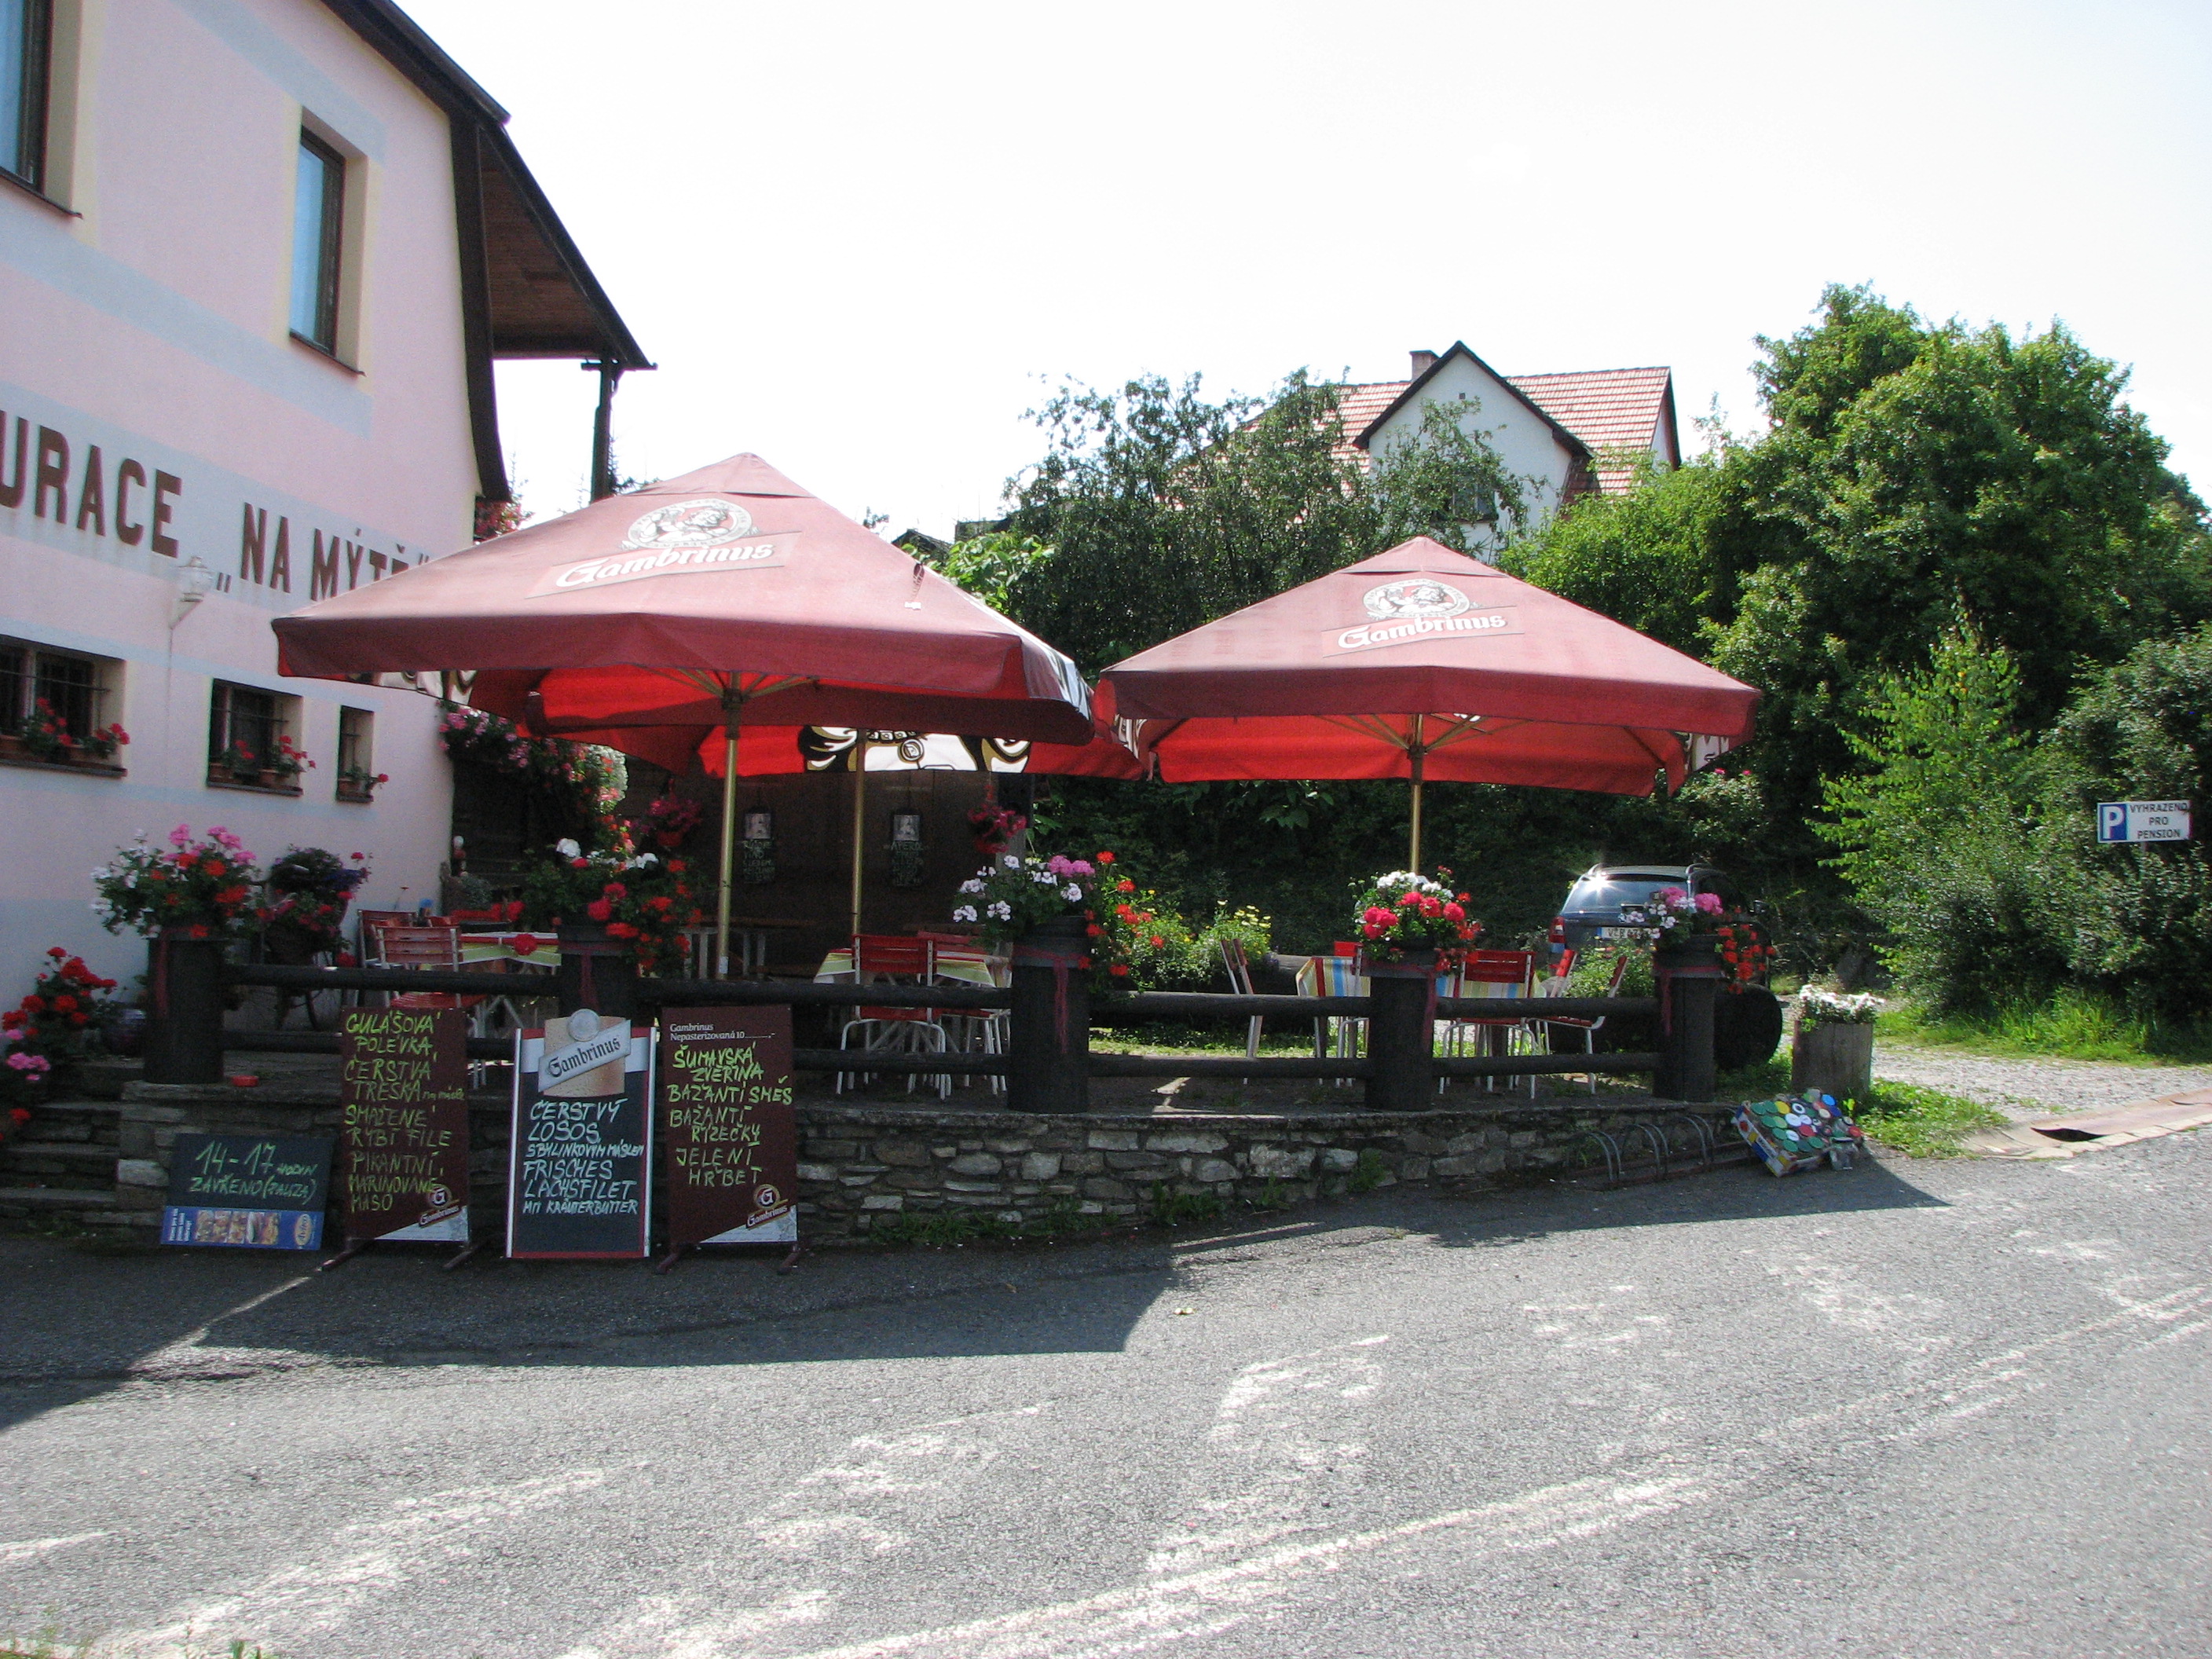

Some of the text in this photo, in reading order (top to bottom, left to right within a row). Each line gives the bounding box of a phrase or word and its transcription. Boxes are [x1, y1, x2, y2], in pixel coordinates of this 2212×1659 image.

[555, 543, 775, 587] Gambrinus
[1338, 615, 1507, 649] Gambrinus
[2102, 805, 2125, 839] P
[2148, 817, 2169, 826] PRO
[2137, 829, 2181, 840] PENSION
[670, 1023, 714, 1032] Gambrinus
[548, 1037, 621, 1078] Gambrinus
[353, 1081, 422, 1101] TRESKA
[523, 1159, 613, 1181] FRISCHES
[525, 1178, 639, 1199] LACHSFILET
